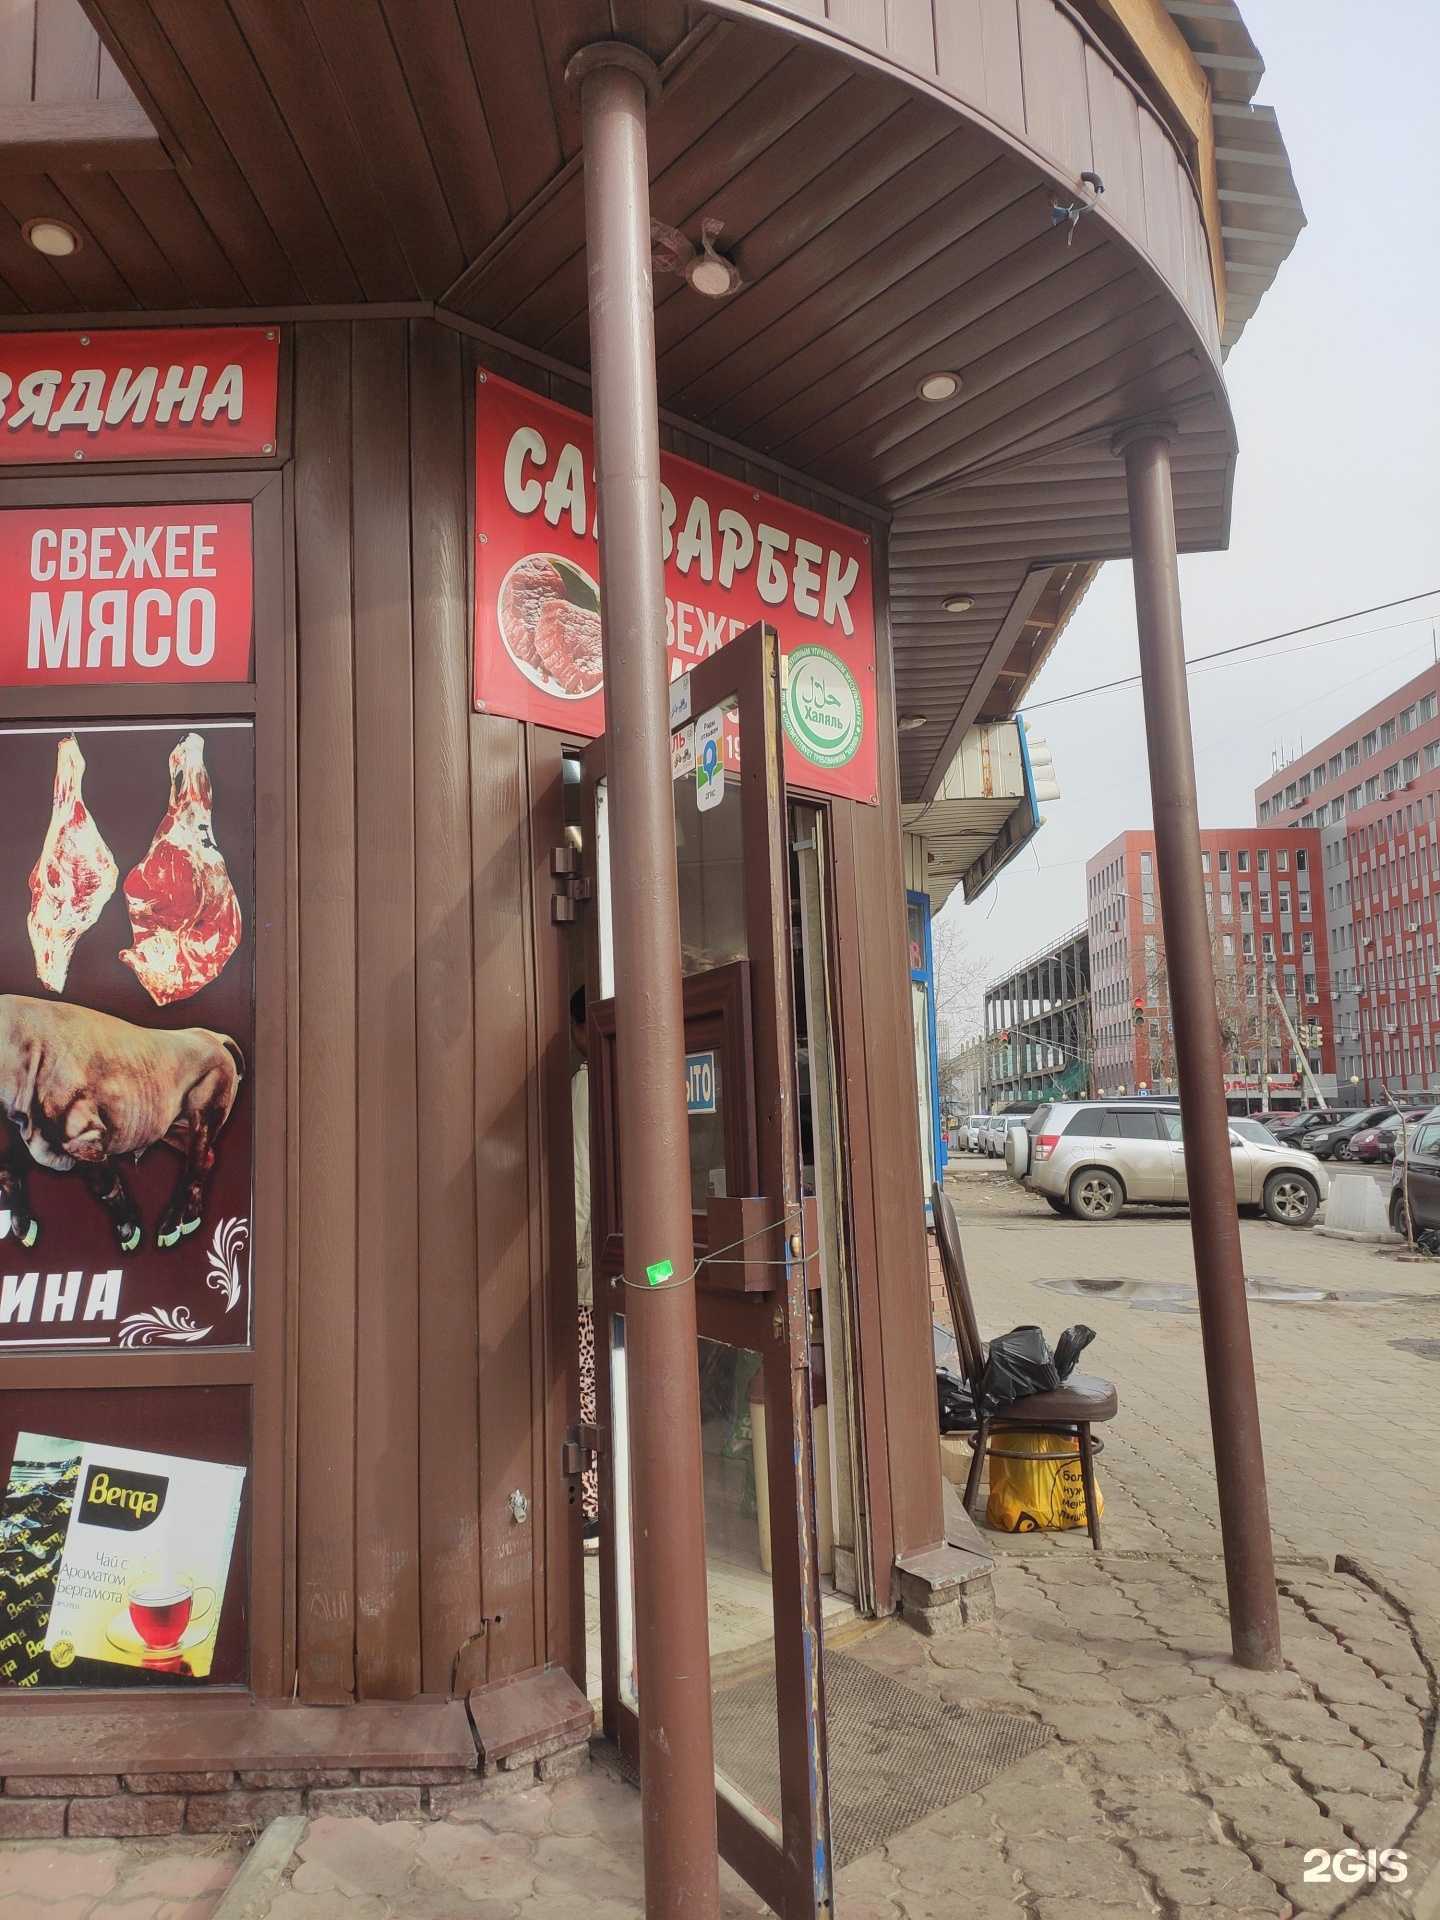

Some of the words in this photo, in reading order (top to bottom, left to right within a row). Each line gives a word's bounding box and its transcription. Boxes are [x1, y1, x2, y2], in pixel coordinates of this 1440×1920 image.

[503, 426, 860, 636] СААРБЕК
[30, 525, 218, 582] СВЕЖЕЕ
[27, 587, 216, 669] МЯСО
[804, 705, 843, 730] Халяль
[96, 1551, 117, 1568] Чай
[120, 1559, 128, 1569] с
[60, 1563, 127, 1586] Ароматом
[56, 1580, 124, 1604] Бергамота
